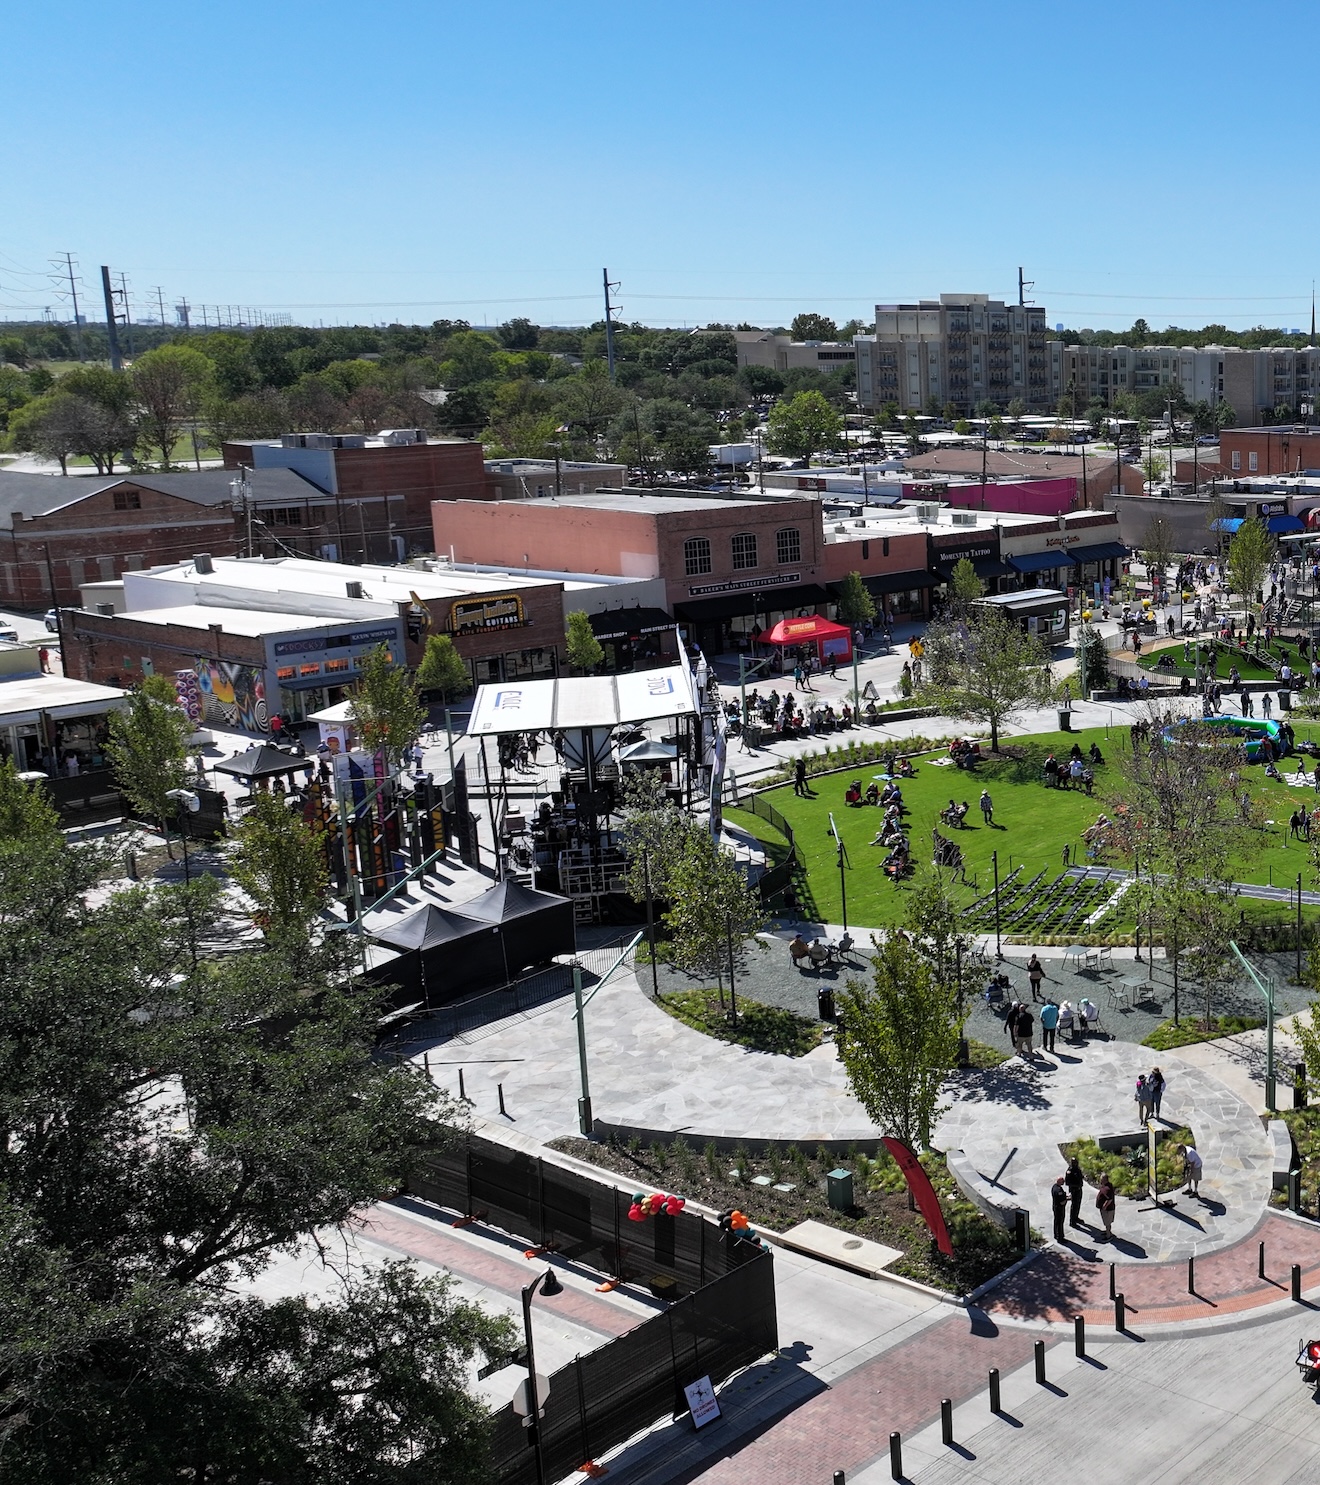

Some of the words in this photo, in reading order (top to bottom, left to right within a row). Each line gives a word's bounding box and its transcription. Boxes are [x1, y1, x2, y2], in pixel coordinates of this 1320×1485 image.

[740, 580, 760, 588] STREET
[760, 576, 791, 585] FURNITURE
[486, 615, 519, 627] GUITARS
[696, 1404, 716, 1419] ALLOWED
